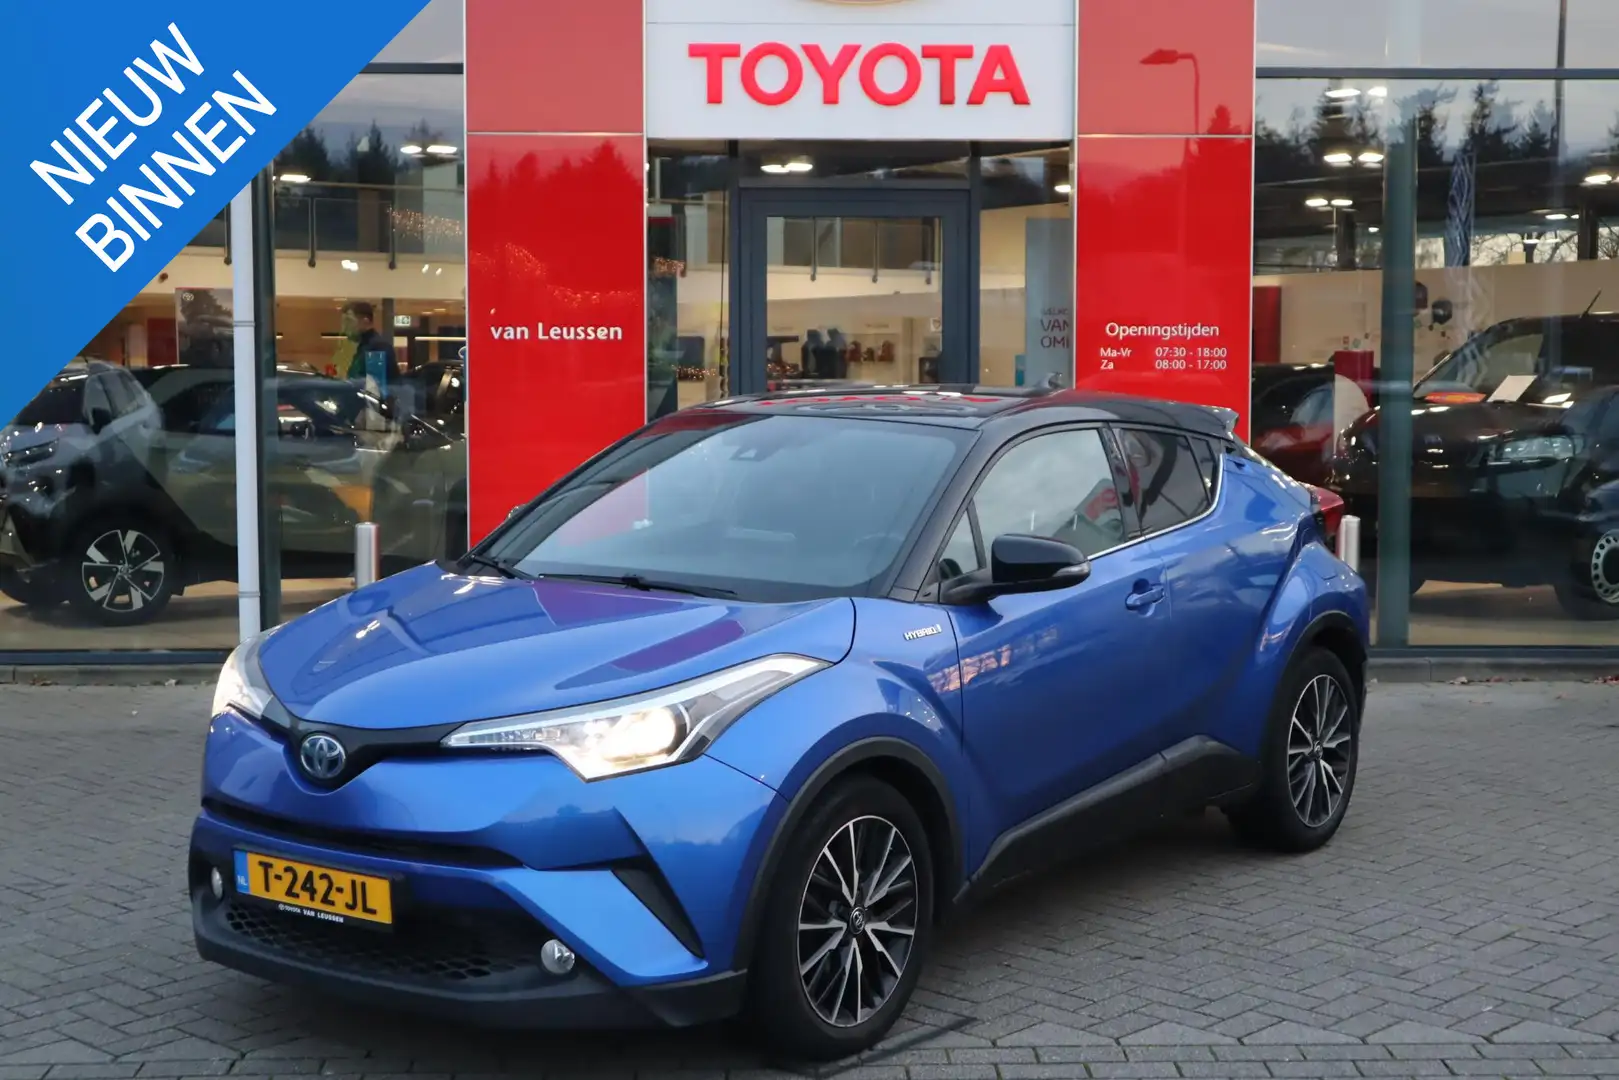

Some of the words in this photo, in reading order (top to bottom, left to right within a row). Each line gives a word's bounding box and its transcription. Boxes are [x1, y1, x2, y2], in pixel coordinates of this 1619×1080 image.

[688, 42, 1031, 106] TOYOTA
[490, 326, 529, 340] van
[538, 322, 623, 340] Leussen
[1105, 322, 1219, 341] Openingstijden
[1100, 347, 1132, 357] Ma-Vr
[1155, 347, 1186, 357] 07:30
[1197, 347, 1227, 357] 18:00
[1100, 360, 1114, 370] Za
[1155, 360, 1186, 369] 08:00
[1197, 360, 1227, 369] 17:00
[237, 875, 248, 887] NL
[258, 860, 378, 915] T-242-JL
[302, 908, 316, 917] VAN
[317, 911, 344, 923] LEUSSEN
